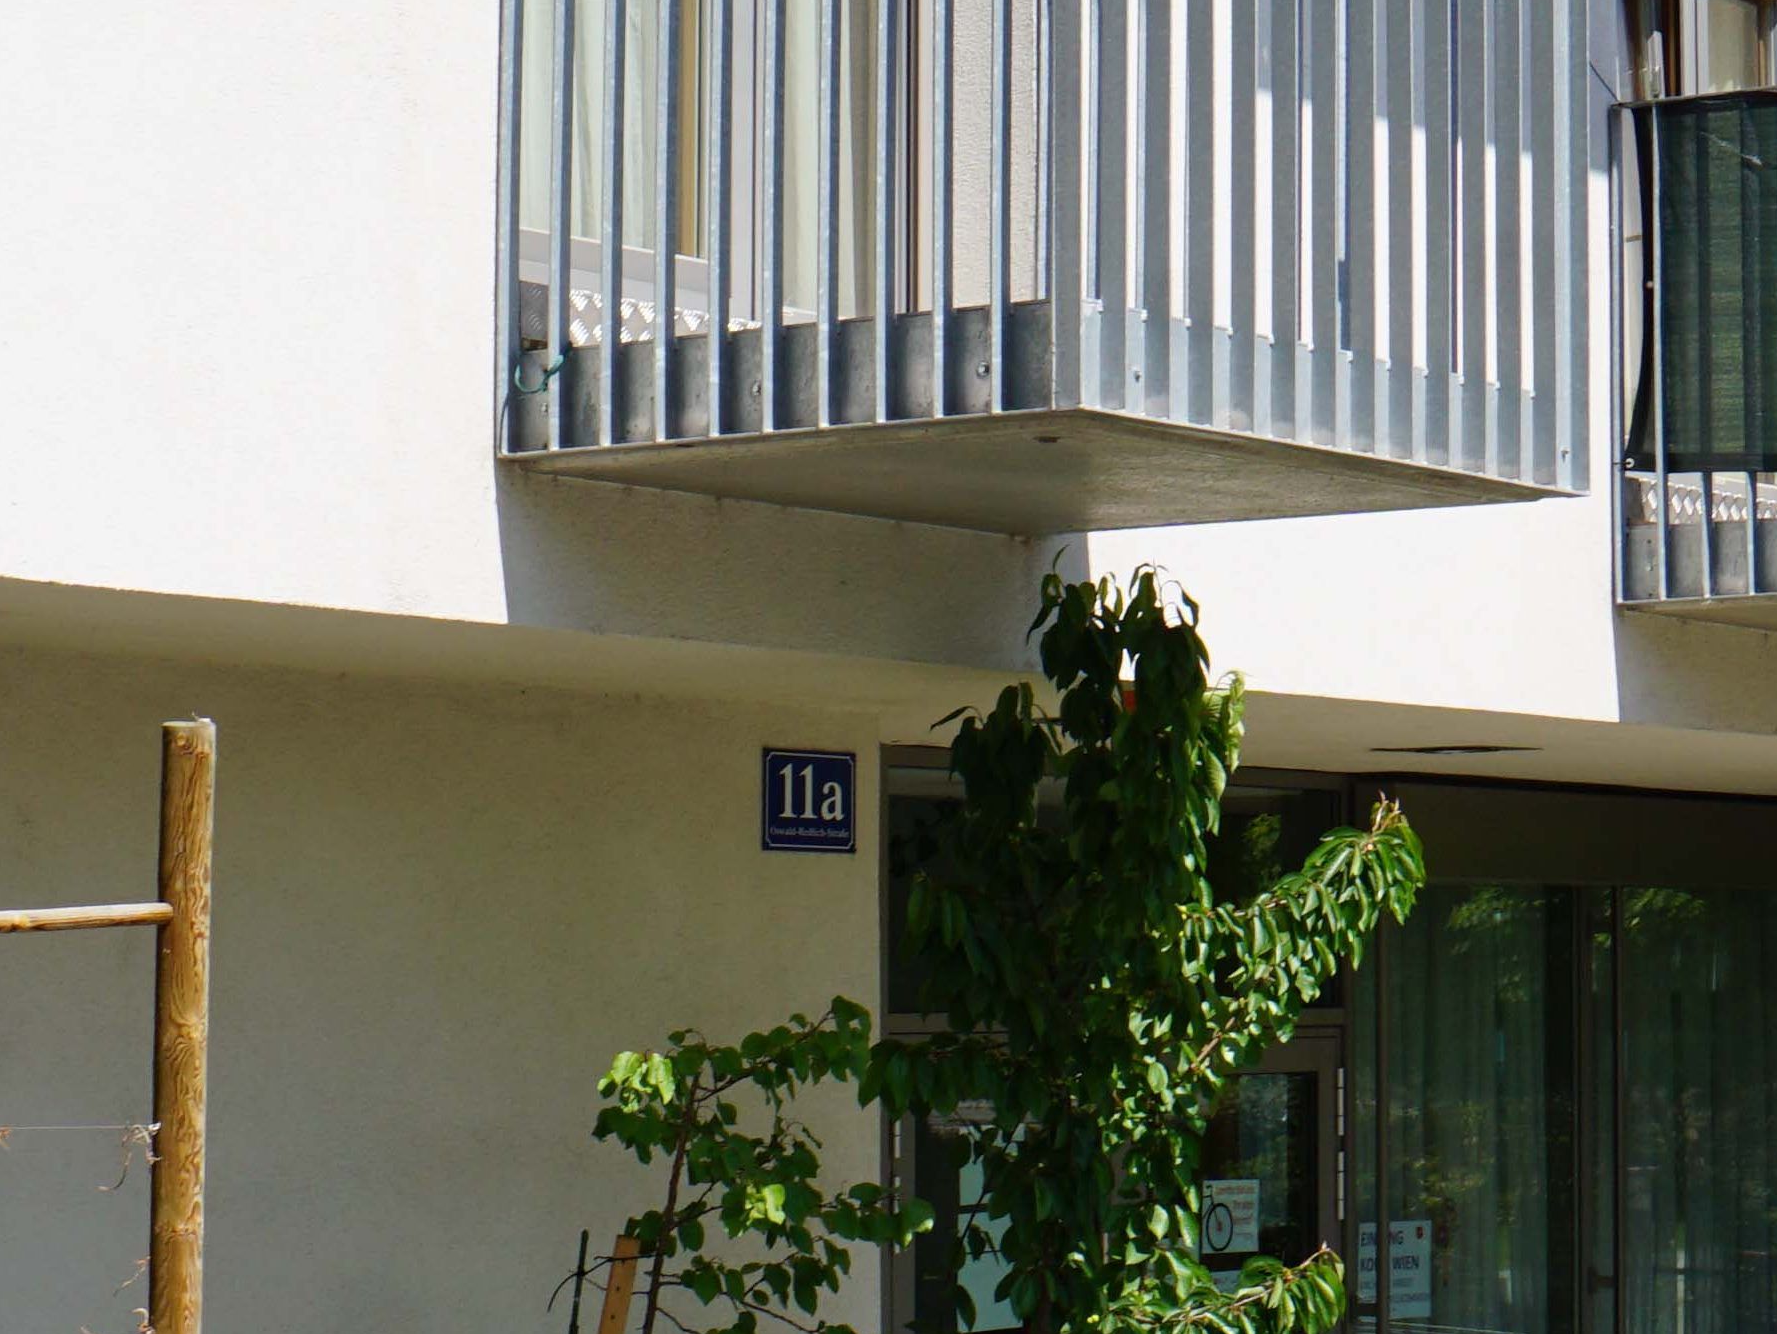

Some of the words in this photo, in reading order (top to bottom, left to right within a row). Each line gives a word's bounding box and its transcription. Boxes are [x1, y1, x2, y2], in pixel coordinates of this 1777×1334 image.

[779, 762, 845, 821] 11a
[1361, 1230, 1404, 1246] EINNG
[1392, 1255, 1420, 1269] WIEN
